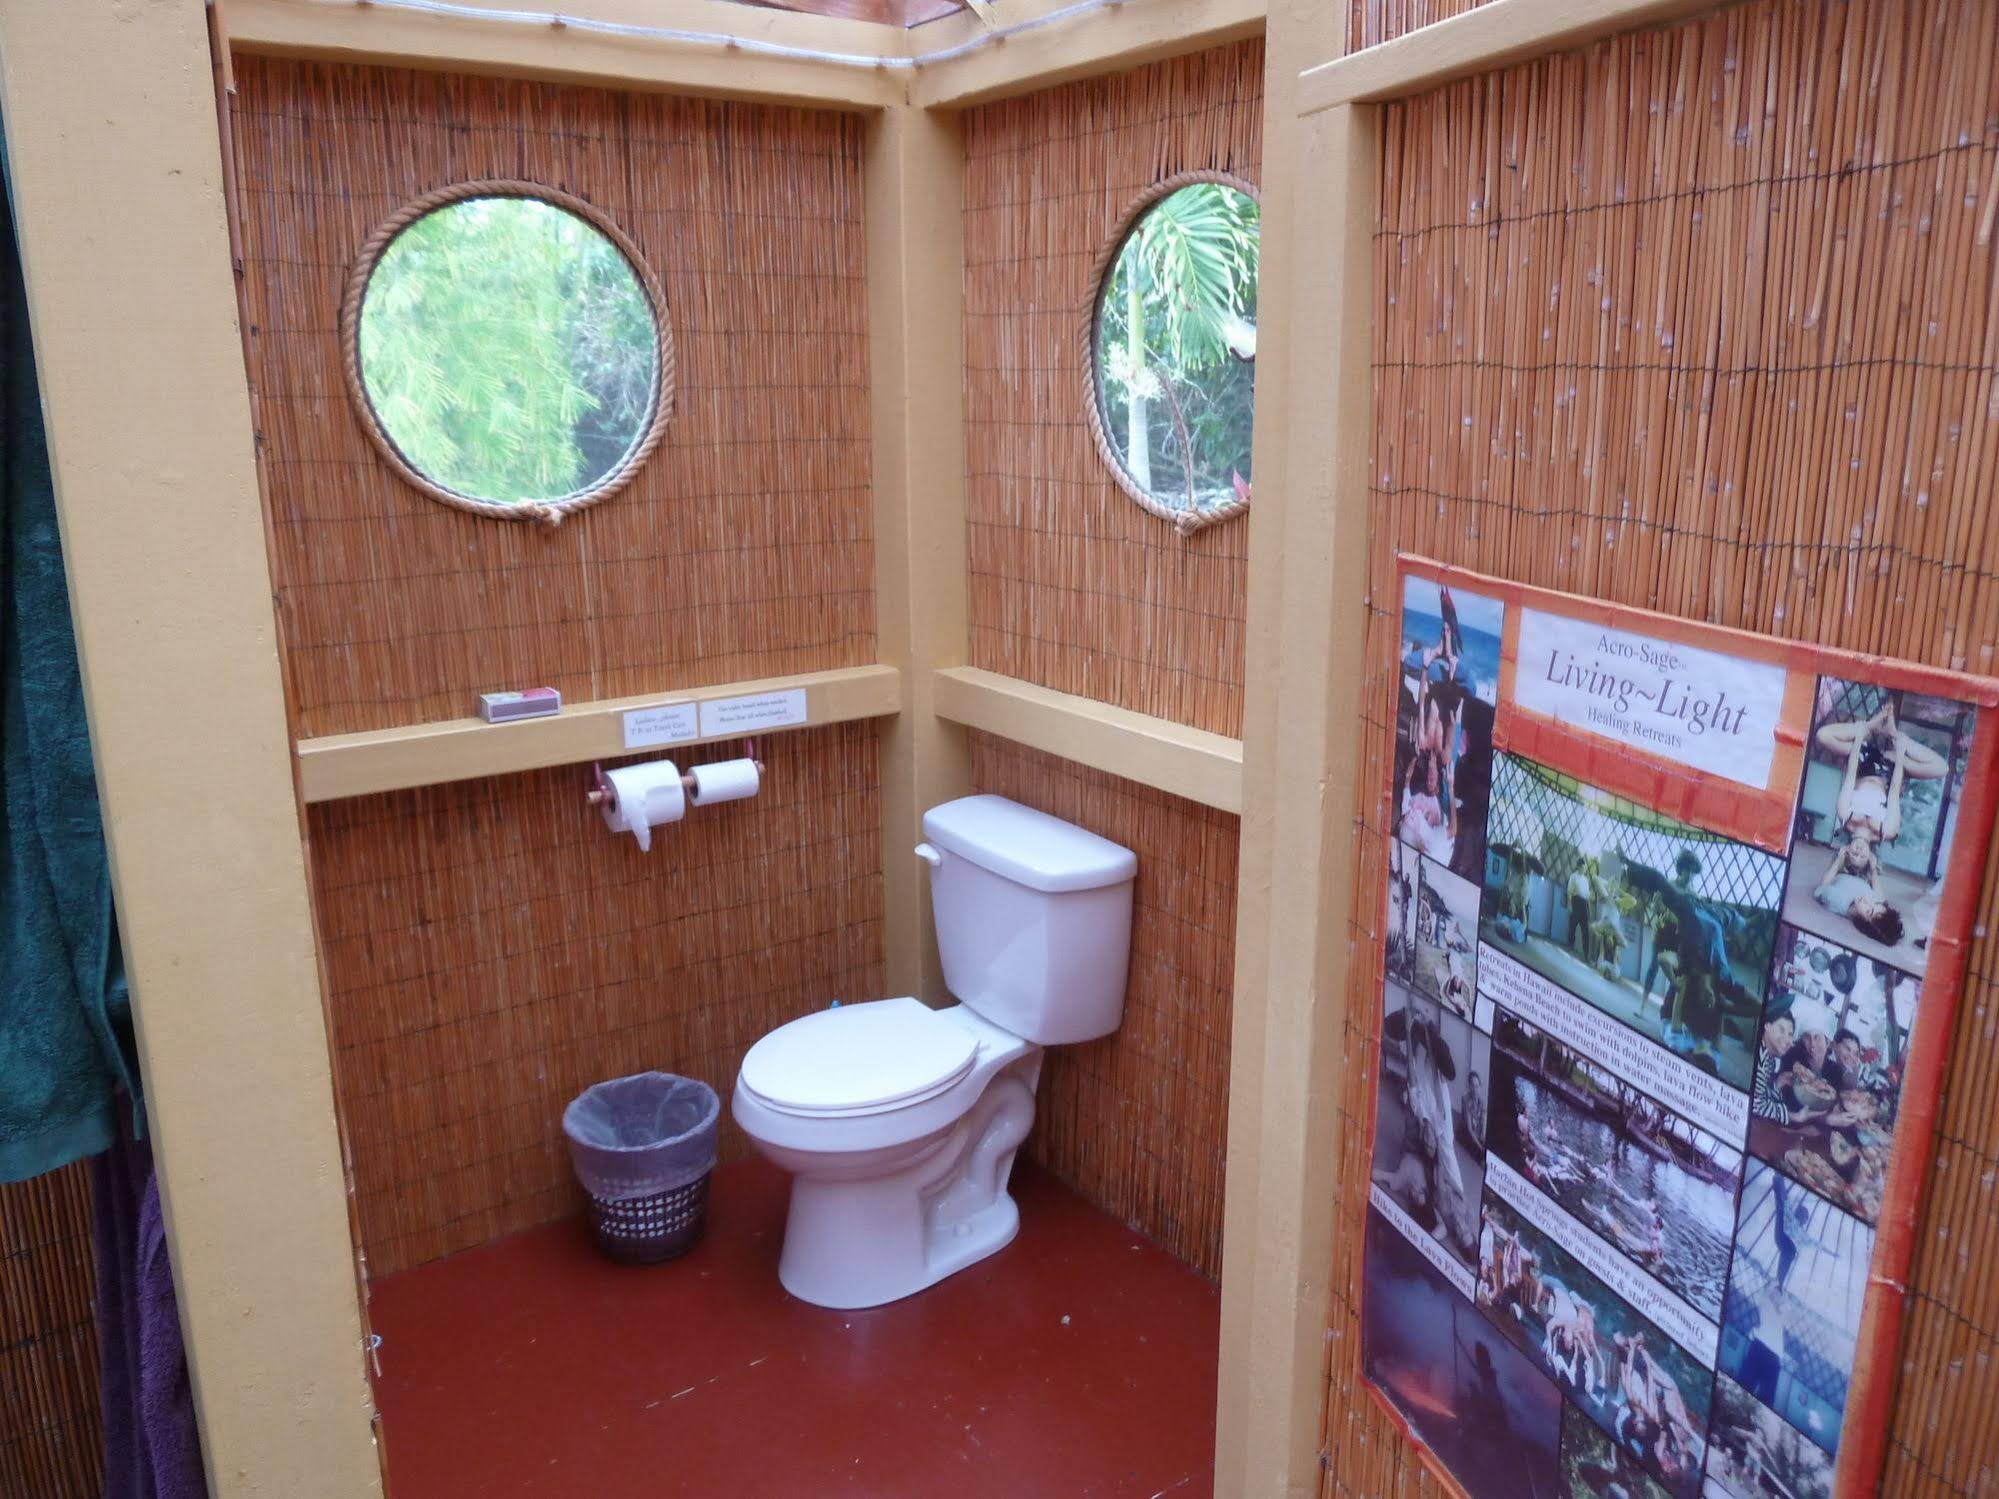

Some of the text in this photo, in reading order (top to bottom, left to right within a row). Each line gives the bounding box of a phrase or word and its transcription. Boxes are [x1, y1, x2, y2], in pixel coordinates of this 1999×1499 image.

[1586, 706, 1682, 748] Healing Retreats
[1513, 966, 1520, 979] in
[1554, 990, 1584, 1016] include
[1639, 1040, 1649, 1054] to
[1651, 1047, 1681, 1073] steam
[1685, 1067, 1716, 1095] vents,
[1719, 1084, 1743, 1109] lava
[1535, 992, 1560, 1016] Beach
[1563, 1010, 1571, 1023] to
[1574, 1016, 1596, 1038] swim
[1599, 1030, 1619, 1052] with
[1663, 1068, 1685, 1091] lava
[1688, 1082, 1712, 1107] flow
[1715, 1098, 1740, 1124] hike
[1540, 1010, 1557, 1029] with
[1611, 1054, 1619, 1067] in
[1623, 1062, 1650, 1086] water
[1632, 1276, 1644, 1292] an
[1646, 1286, 1704, 1342] opportunity
